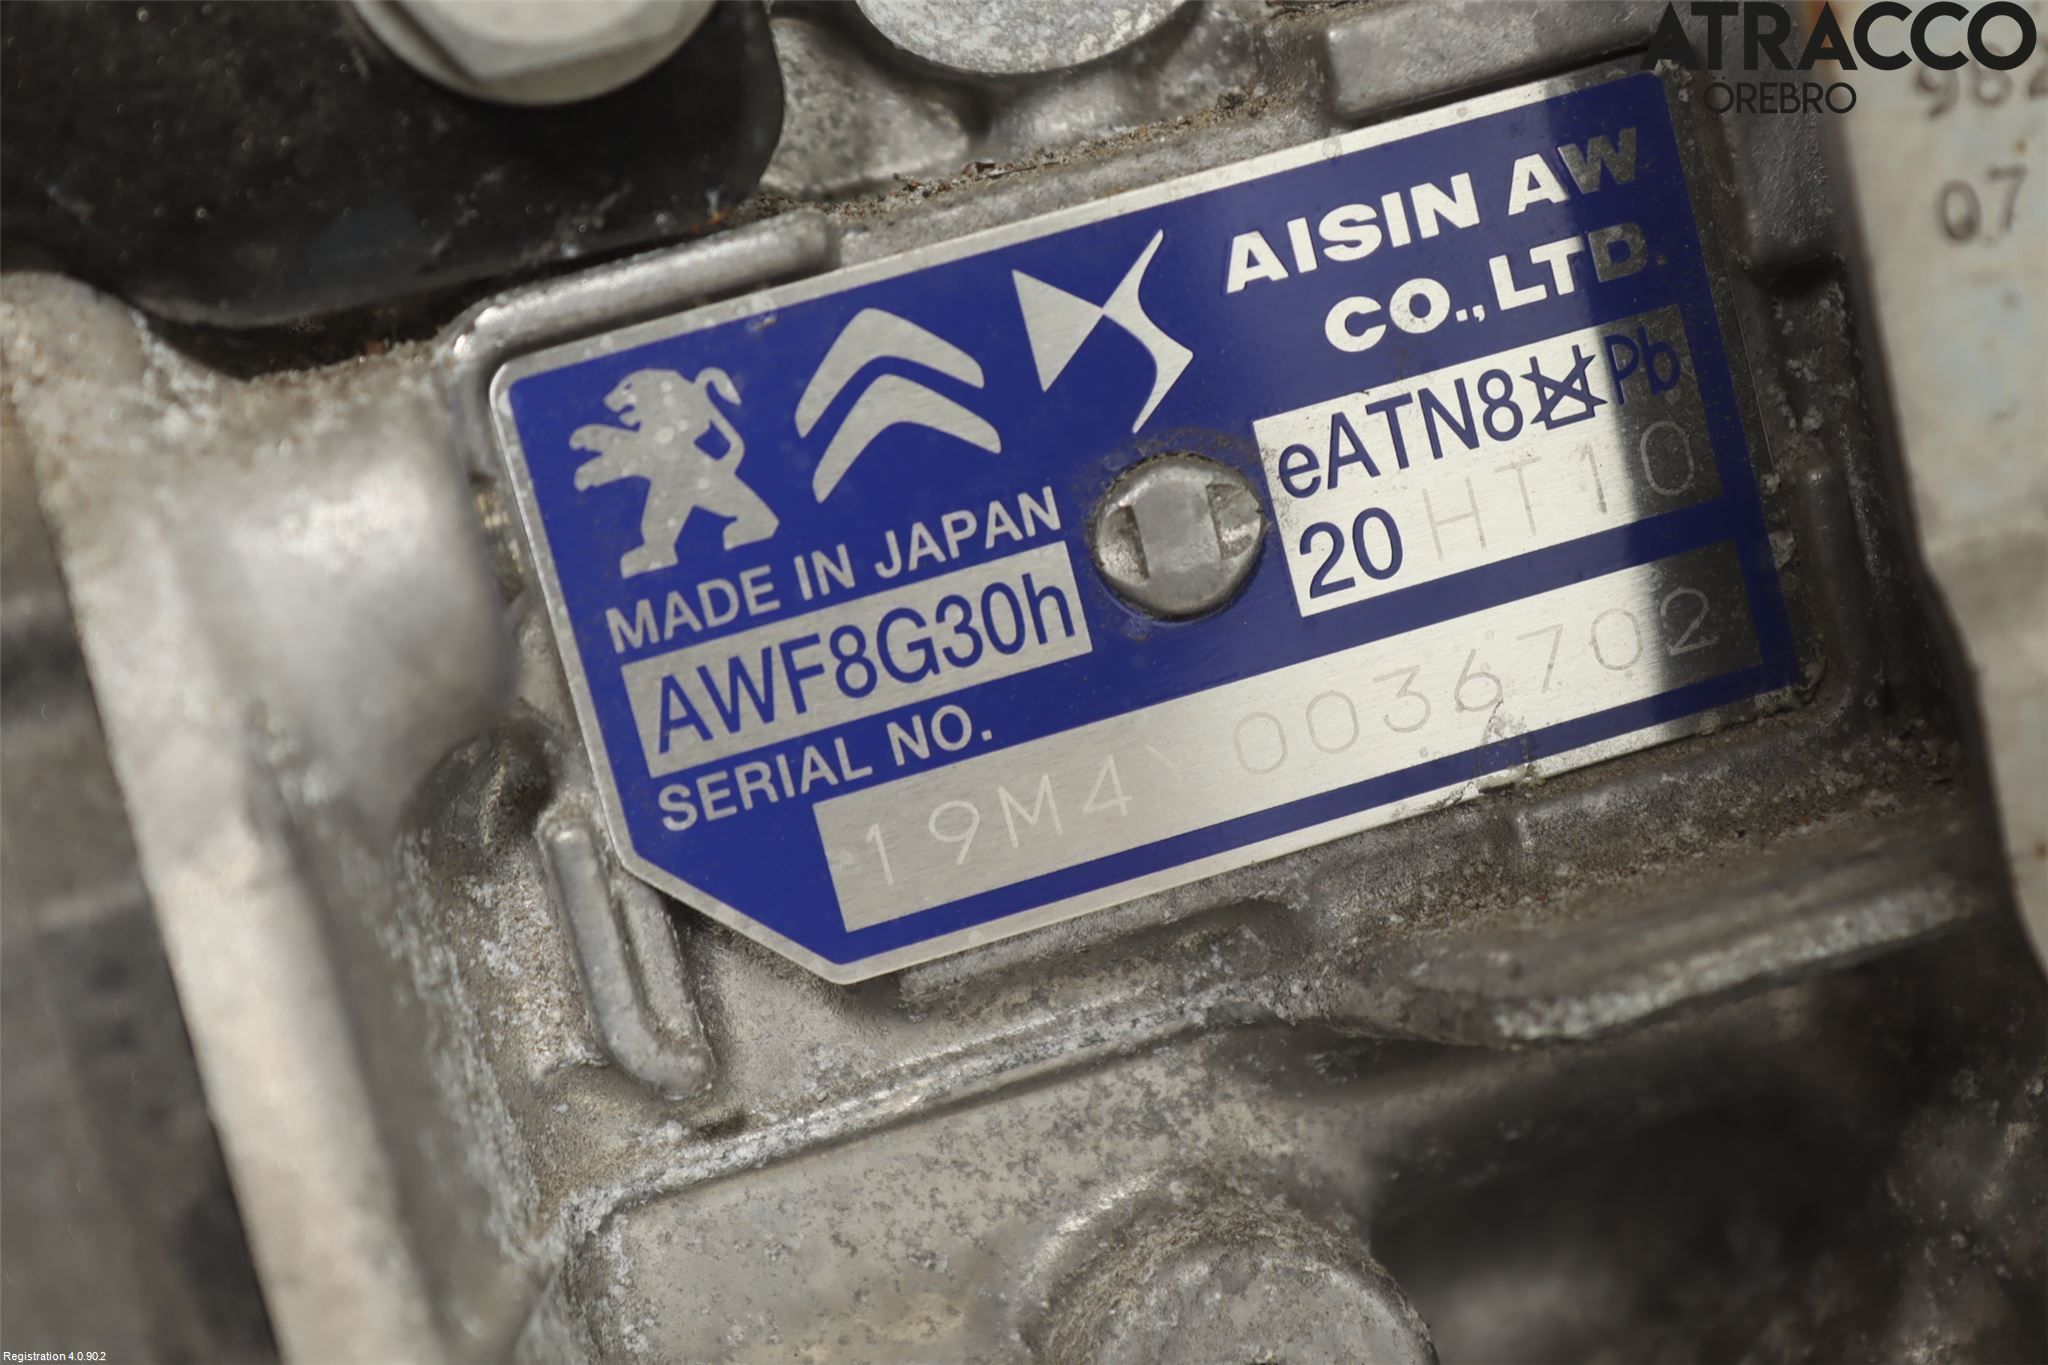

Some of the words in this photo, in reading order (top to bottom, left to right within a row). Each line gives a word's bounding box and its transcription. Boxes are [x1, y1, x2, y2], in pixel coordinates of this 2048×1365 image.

[1224, 172, 1480, 294] AISIN
[1506, 127, 1638, 214] AW
[605, 565, 781, 653] MADE
[793, 544, 857, 600] IN
[874, 486, 1062, 579] JAPAN
[657, 572, 1076, 756] AWF8G30h
[657, 738, 873, 832] SERIAL
[887, 704, 994, 767] NO.
